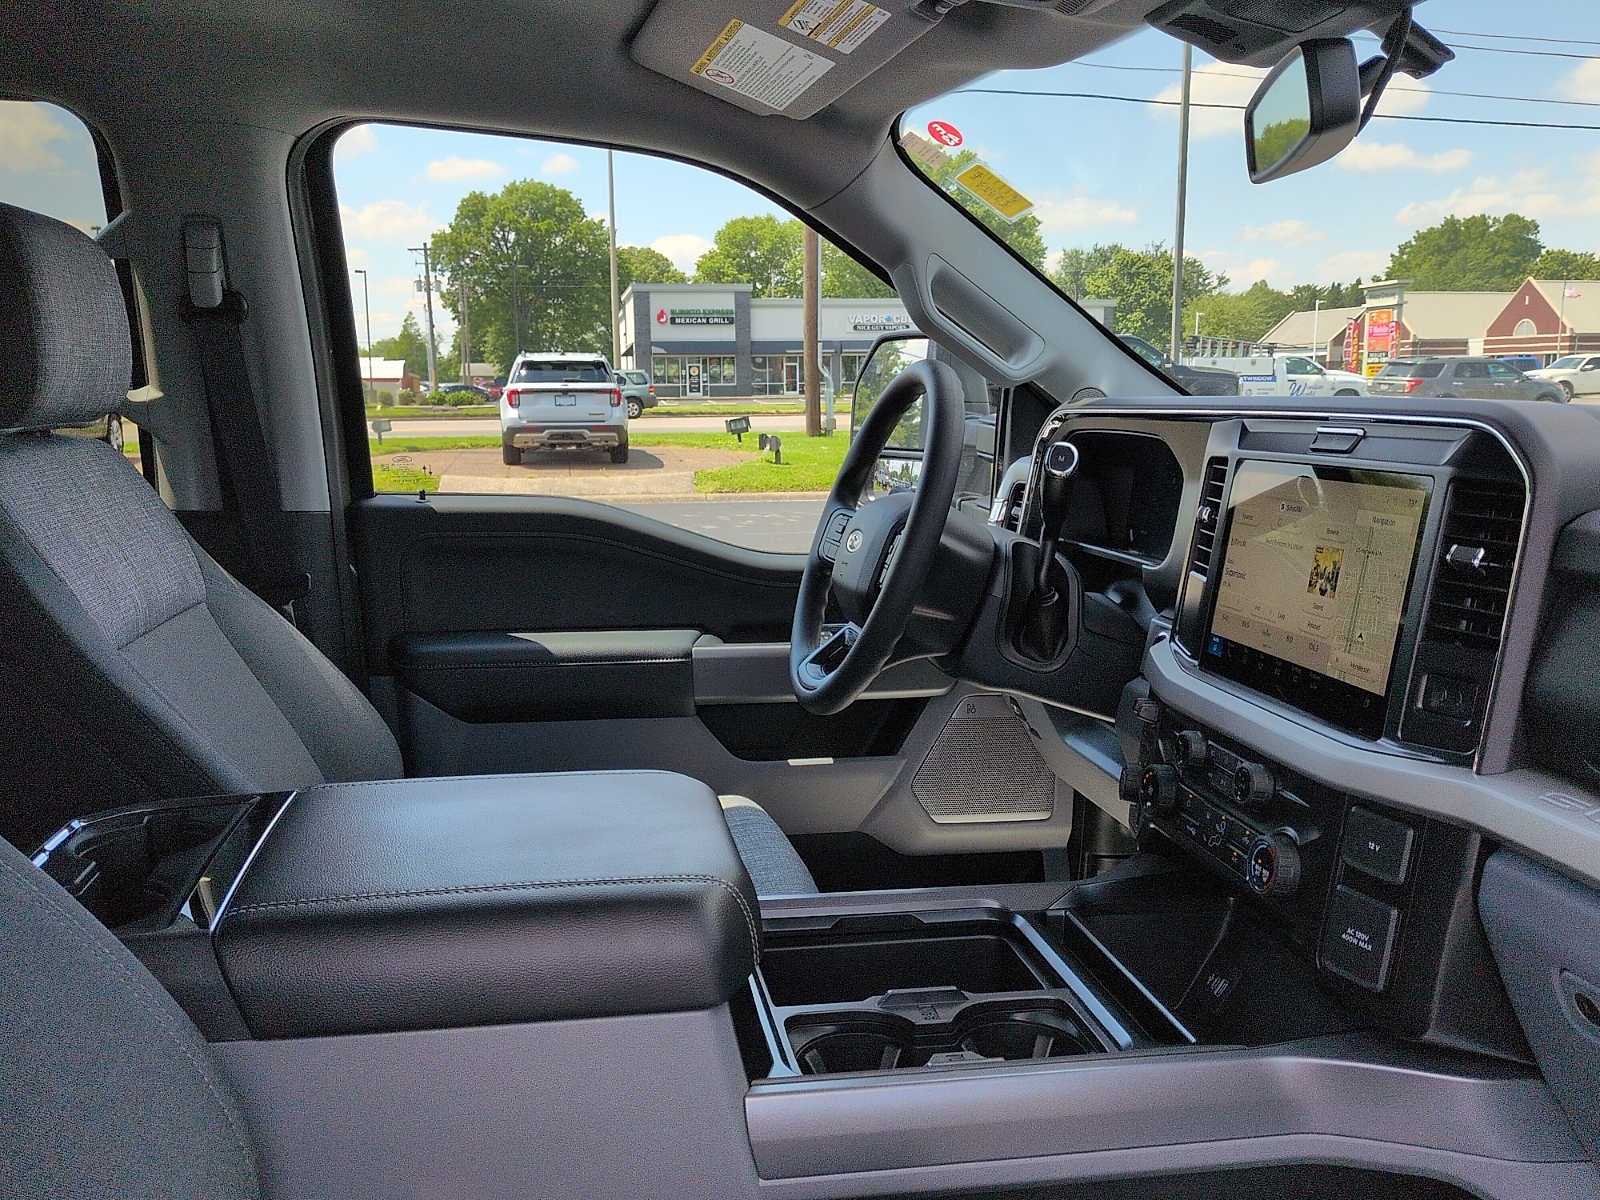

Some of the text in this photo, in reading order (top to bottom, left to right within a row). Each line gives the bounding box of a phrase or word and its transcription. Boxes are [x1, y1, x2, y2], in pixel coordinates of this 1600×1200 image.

[848, 313, 884, 324] VAPOR
[1346, 927, 1355, 936] AC
[1358, 940, 1372, 951] MAX
